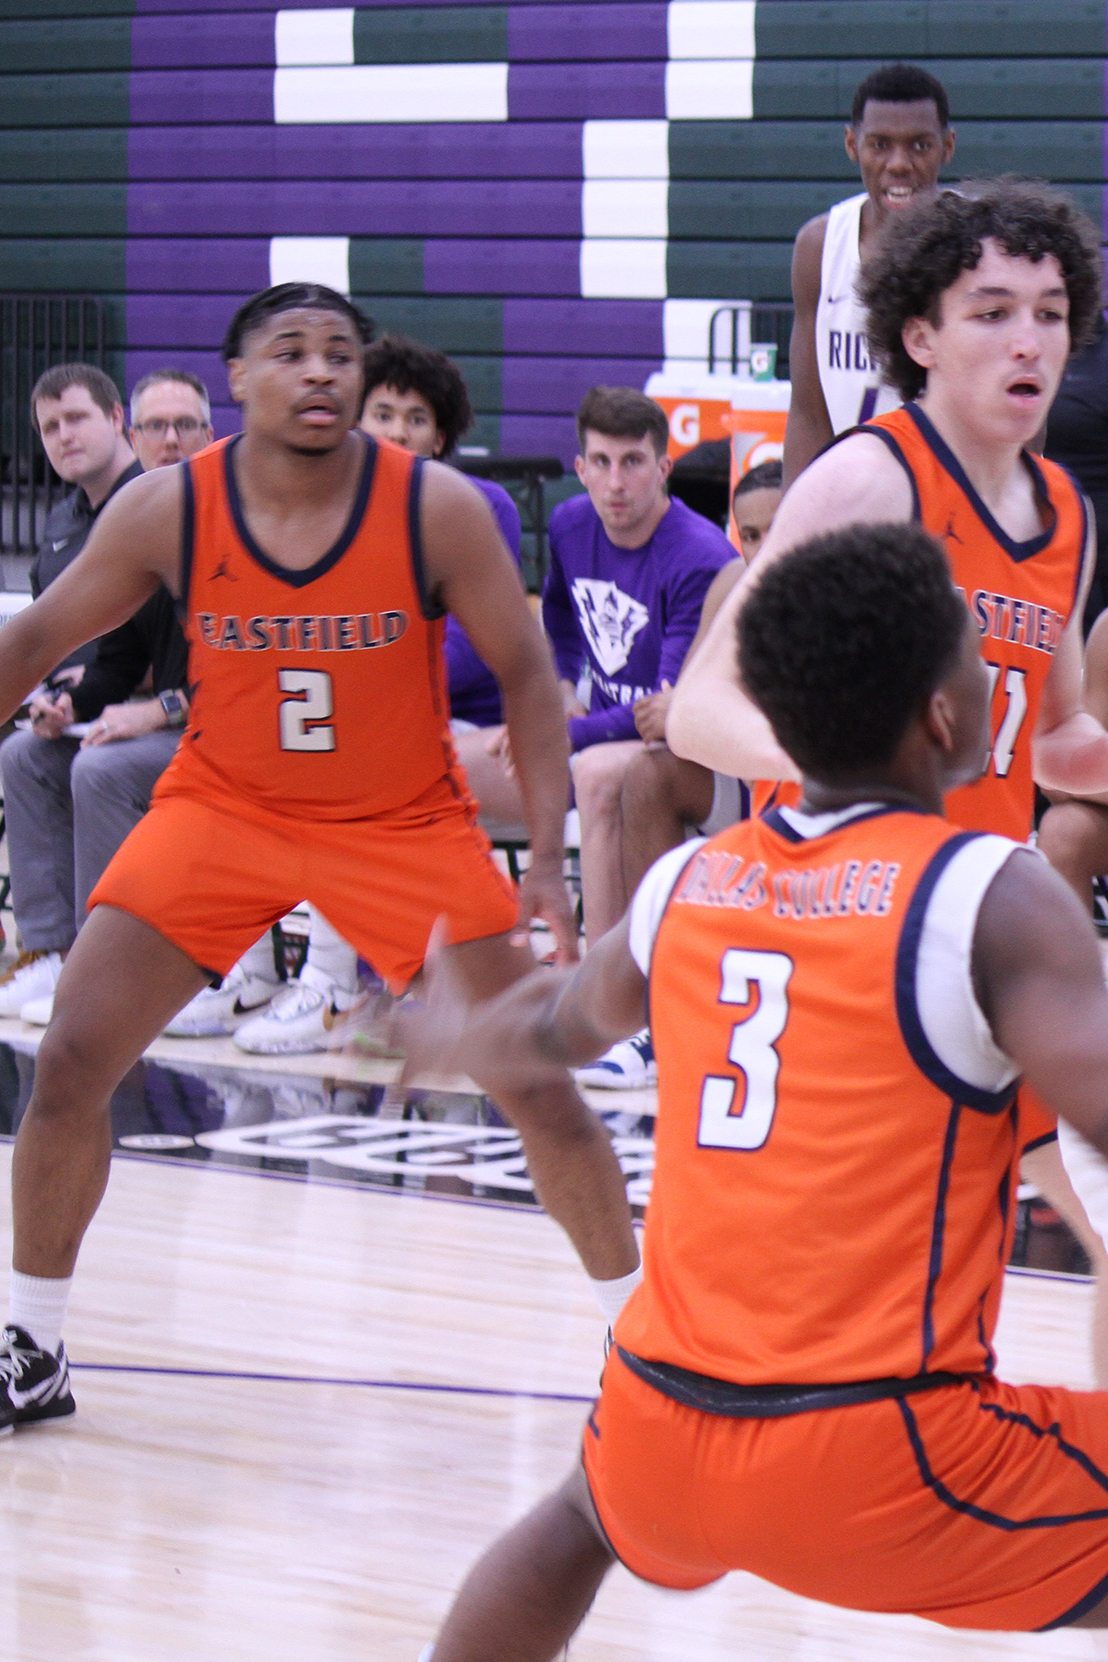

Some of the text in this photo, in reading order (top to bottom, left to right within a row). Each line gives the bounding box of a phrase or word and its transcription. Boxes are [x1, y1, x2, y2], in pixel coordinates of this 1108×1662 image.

[669, 403, 700, 447] G
[195, 609, 411, 652] EASTFIELD
[277, 666, 336, 753] 2
[771, 859, 900, 920] COLLEGE
[697, 947, 795, 1152] 3
